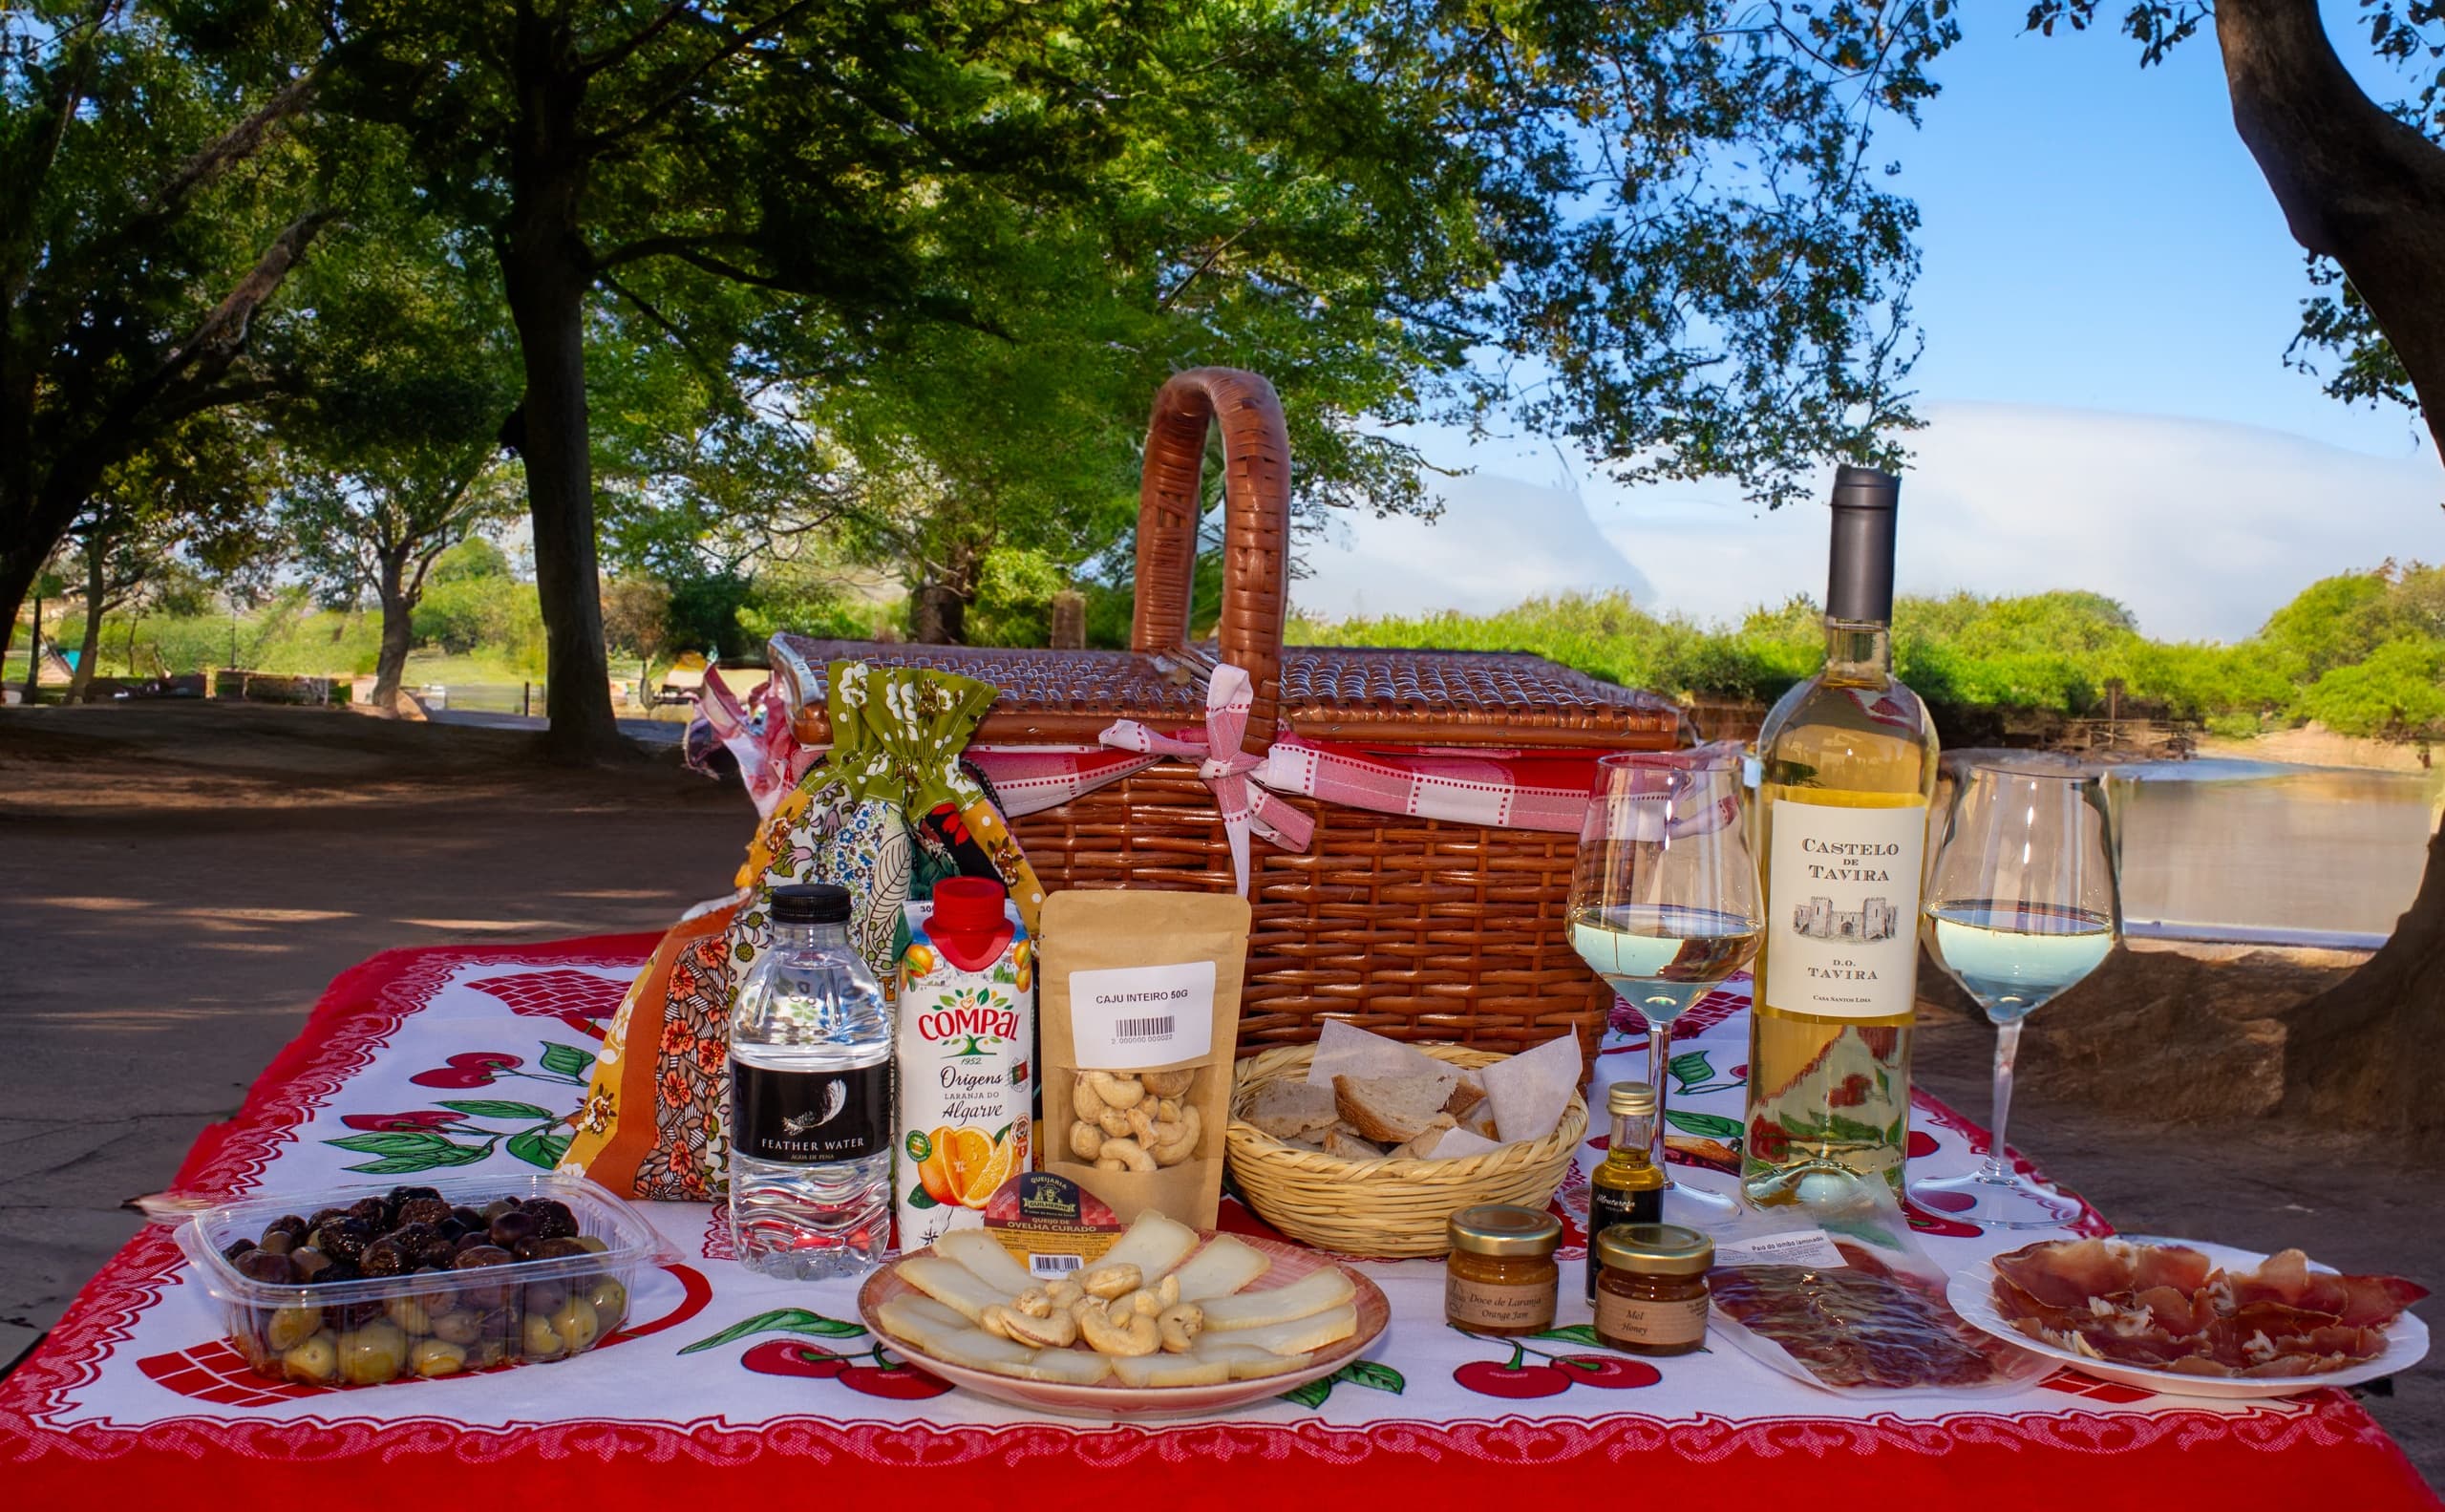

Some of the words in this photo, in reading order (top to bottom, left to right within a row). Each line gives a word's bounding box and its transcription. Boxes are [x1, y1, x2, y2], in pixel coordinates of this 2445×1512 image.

[1801, 838, 1900, 856] CASTELO
[1843, 858, 1860, 866] DE
[1808, 864, 1890, 882] TAVIRA
[1807, 967, 1879, 980] TAVIRA
[1095, 994, 1124, 1005] CAJU
[1126, 991, 1169, 1003] INTEIRO
[1170, 989, 1189, 999] 50G
[940, 1065, 1004, 1091] Origens
[942, 1100, 1004, 1126] Algarve
[761, 1138, 819, 1152] FEATHER
[824, 1138, 865, 1151] WATER
[1031, 1176, 1069, 1191] QUEIJARIA
[1007, 1221, 1051, 1231] OVELHA
[1051, 1224, 1097, 1233] CURADO
[1031, 1217, 1059, 1225] QUEIJO
[1469, 1293, 1493, 1306] Doce
[1494, 1296, 1506, 1307] de
[1507, 1296, 1541, 1308] Laranja
[1481, 1310, 1511, 1322] Orange
[1511, 1311, 1529, 1321] Jam
[1626, 1310, 1645, 1321] Mel
[1621, 1322, 1648, 1335] Honey
